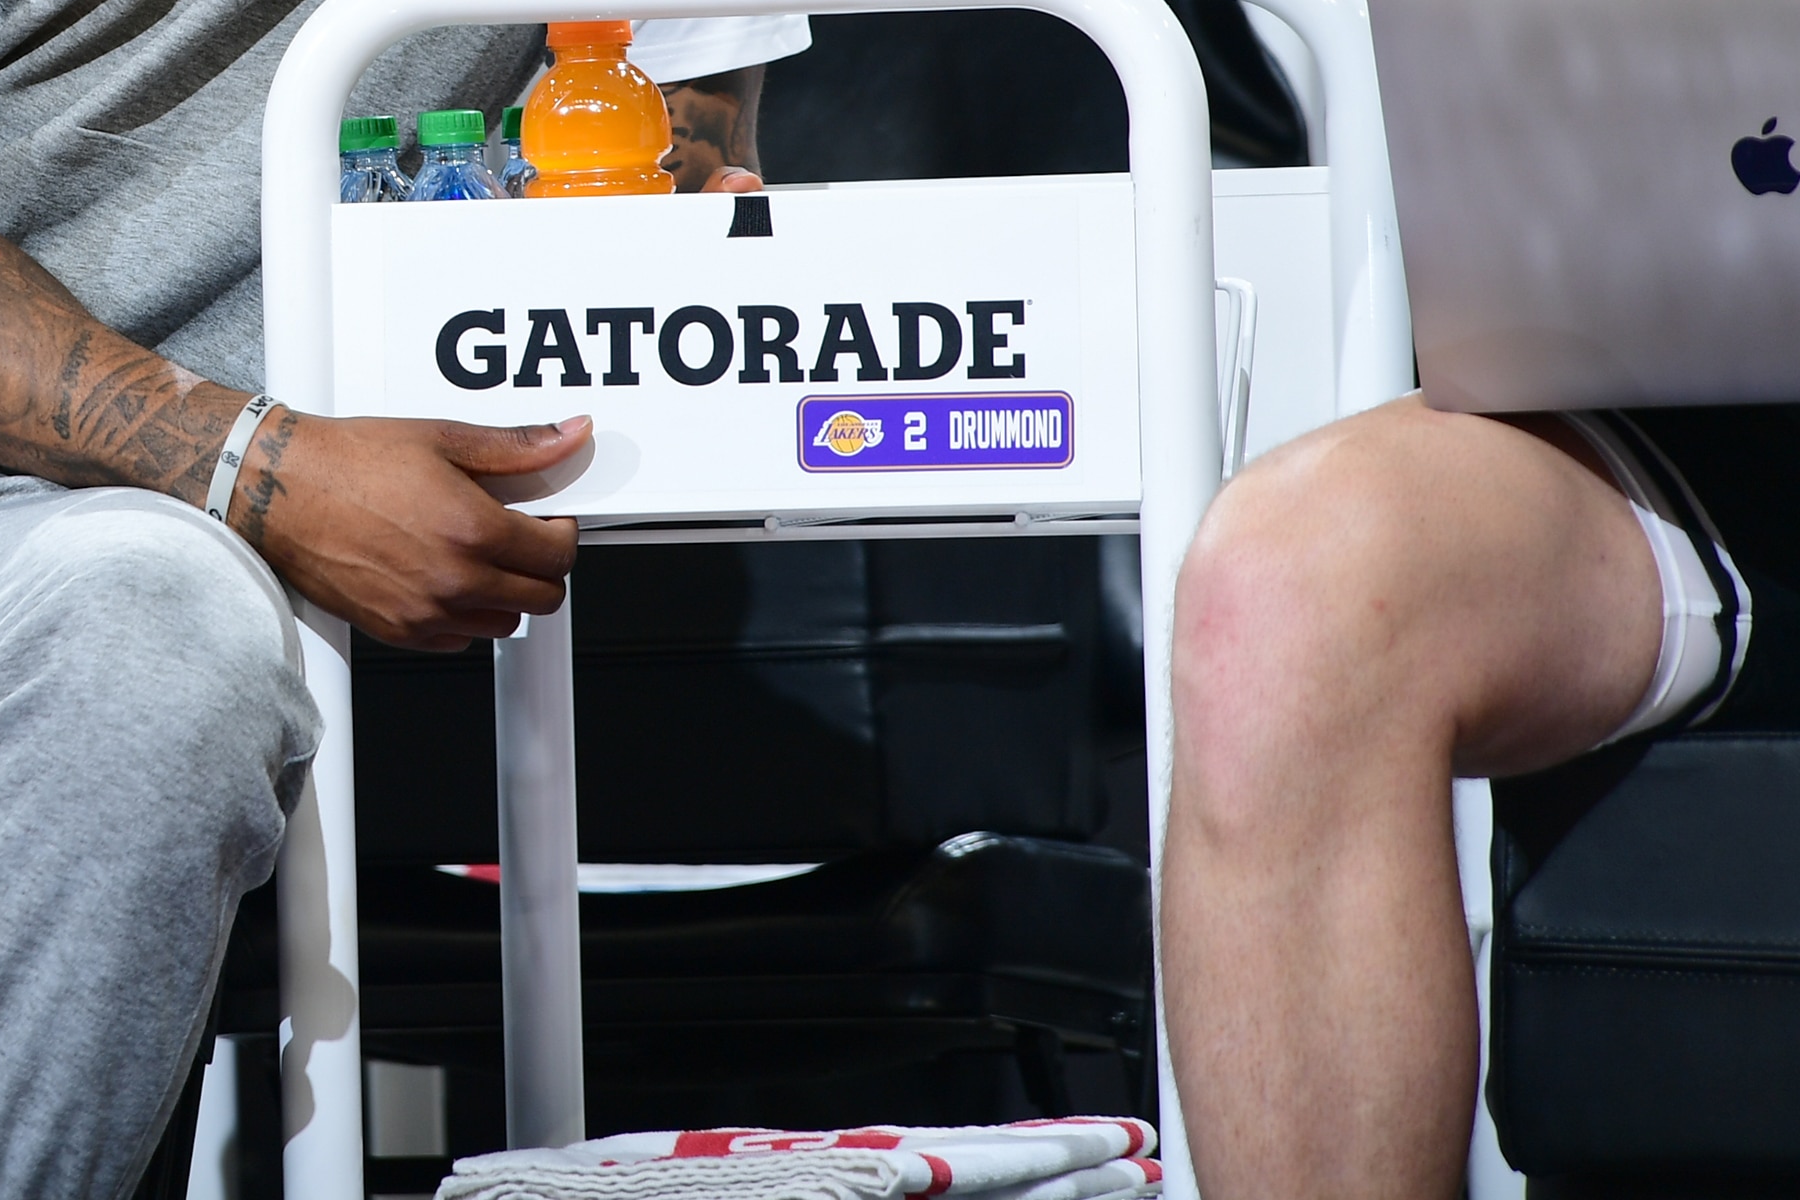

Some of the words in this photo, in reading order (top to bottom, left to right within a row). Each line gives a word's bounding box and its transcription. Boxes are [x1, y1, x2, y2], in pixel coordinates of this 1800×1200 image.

[435, 300, 1026, 390] GATORADE
[903, 411, 927, 451] 2
[949, 408, 1062, 450] DRUMMOND
